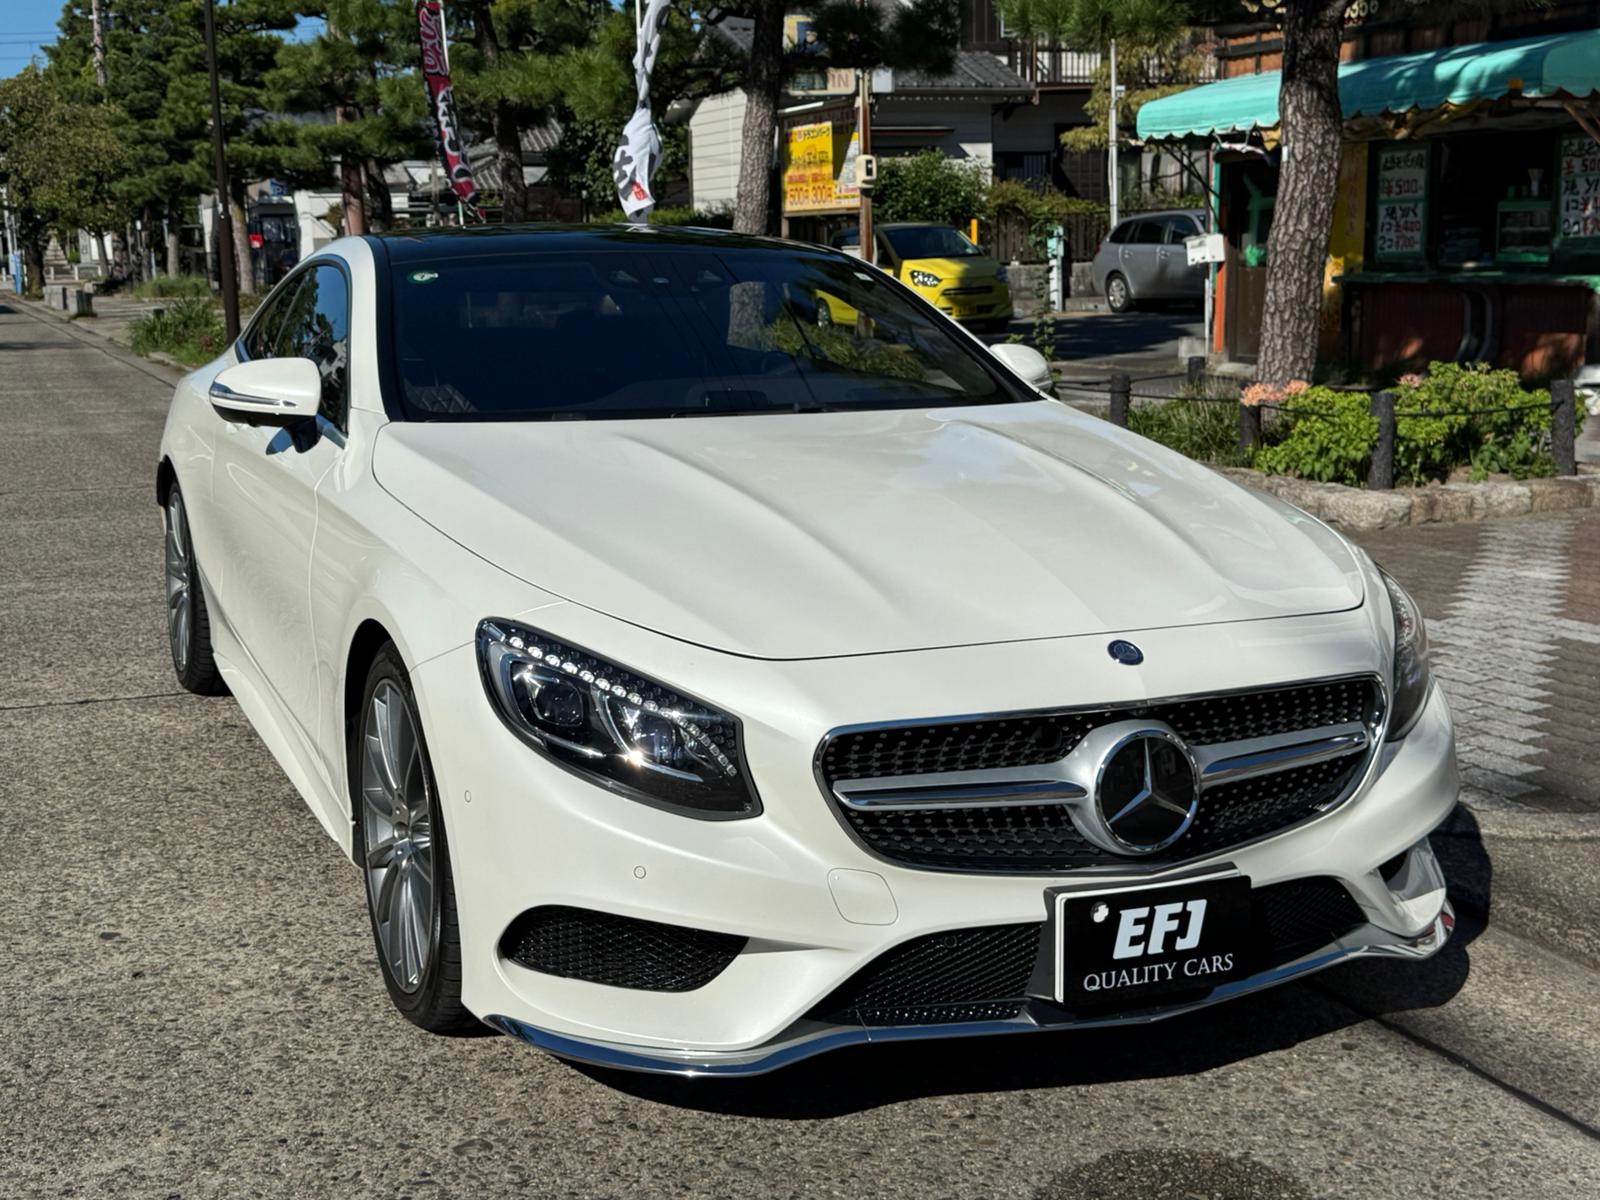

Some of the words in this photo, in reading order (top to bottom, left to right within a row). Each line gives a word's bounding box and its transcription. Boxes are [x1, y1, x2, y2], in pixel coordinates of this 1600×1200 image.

[1112, 898, 1208, 960] EFJ
[1083, 961, 1177, 991] QUALITY
[1183, 952, 1234, 977] CARS
